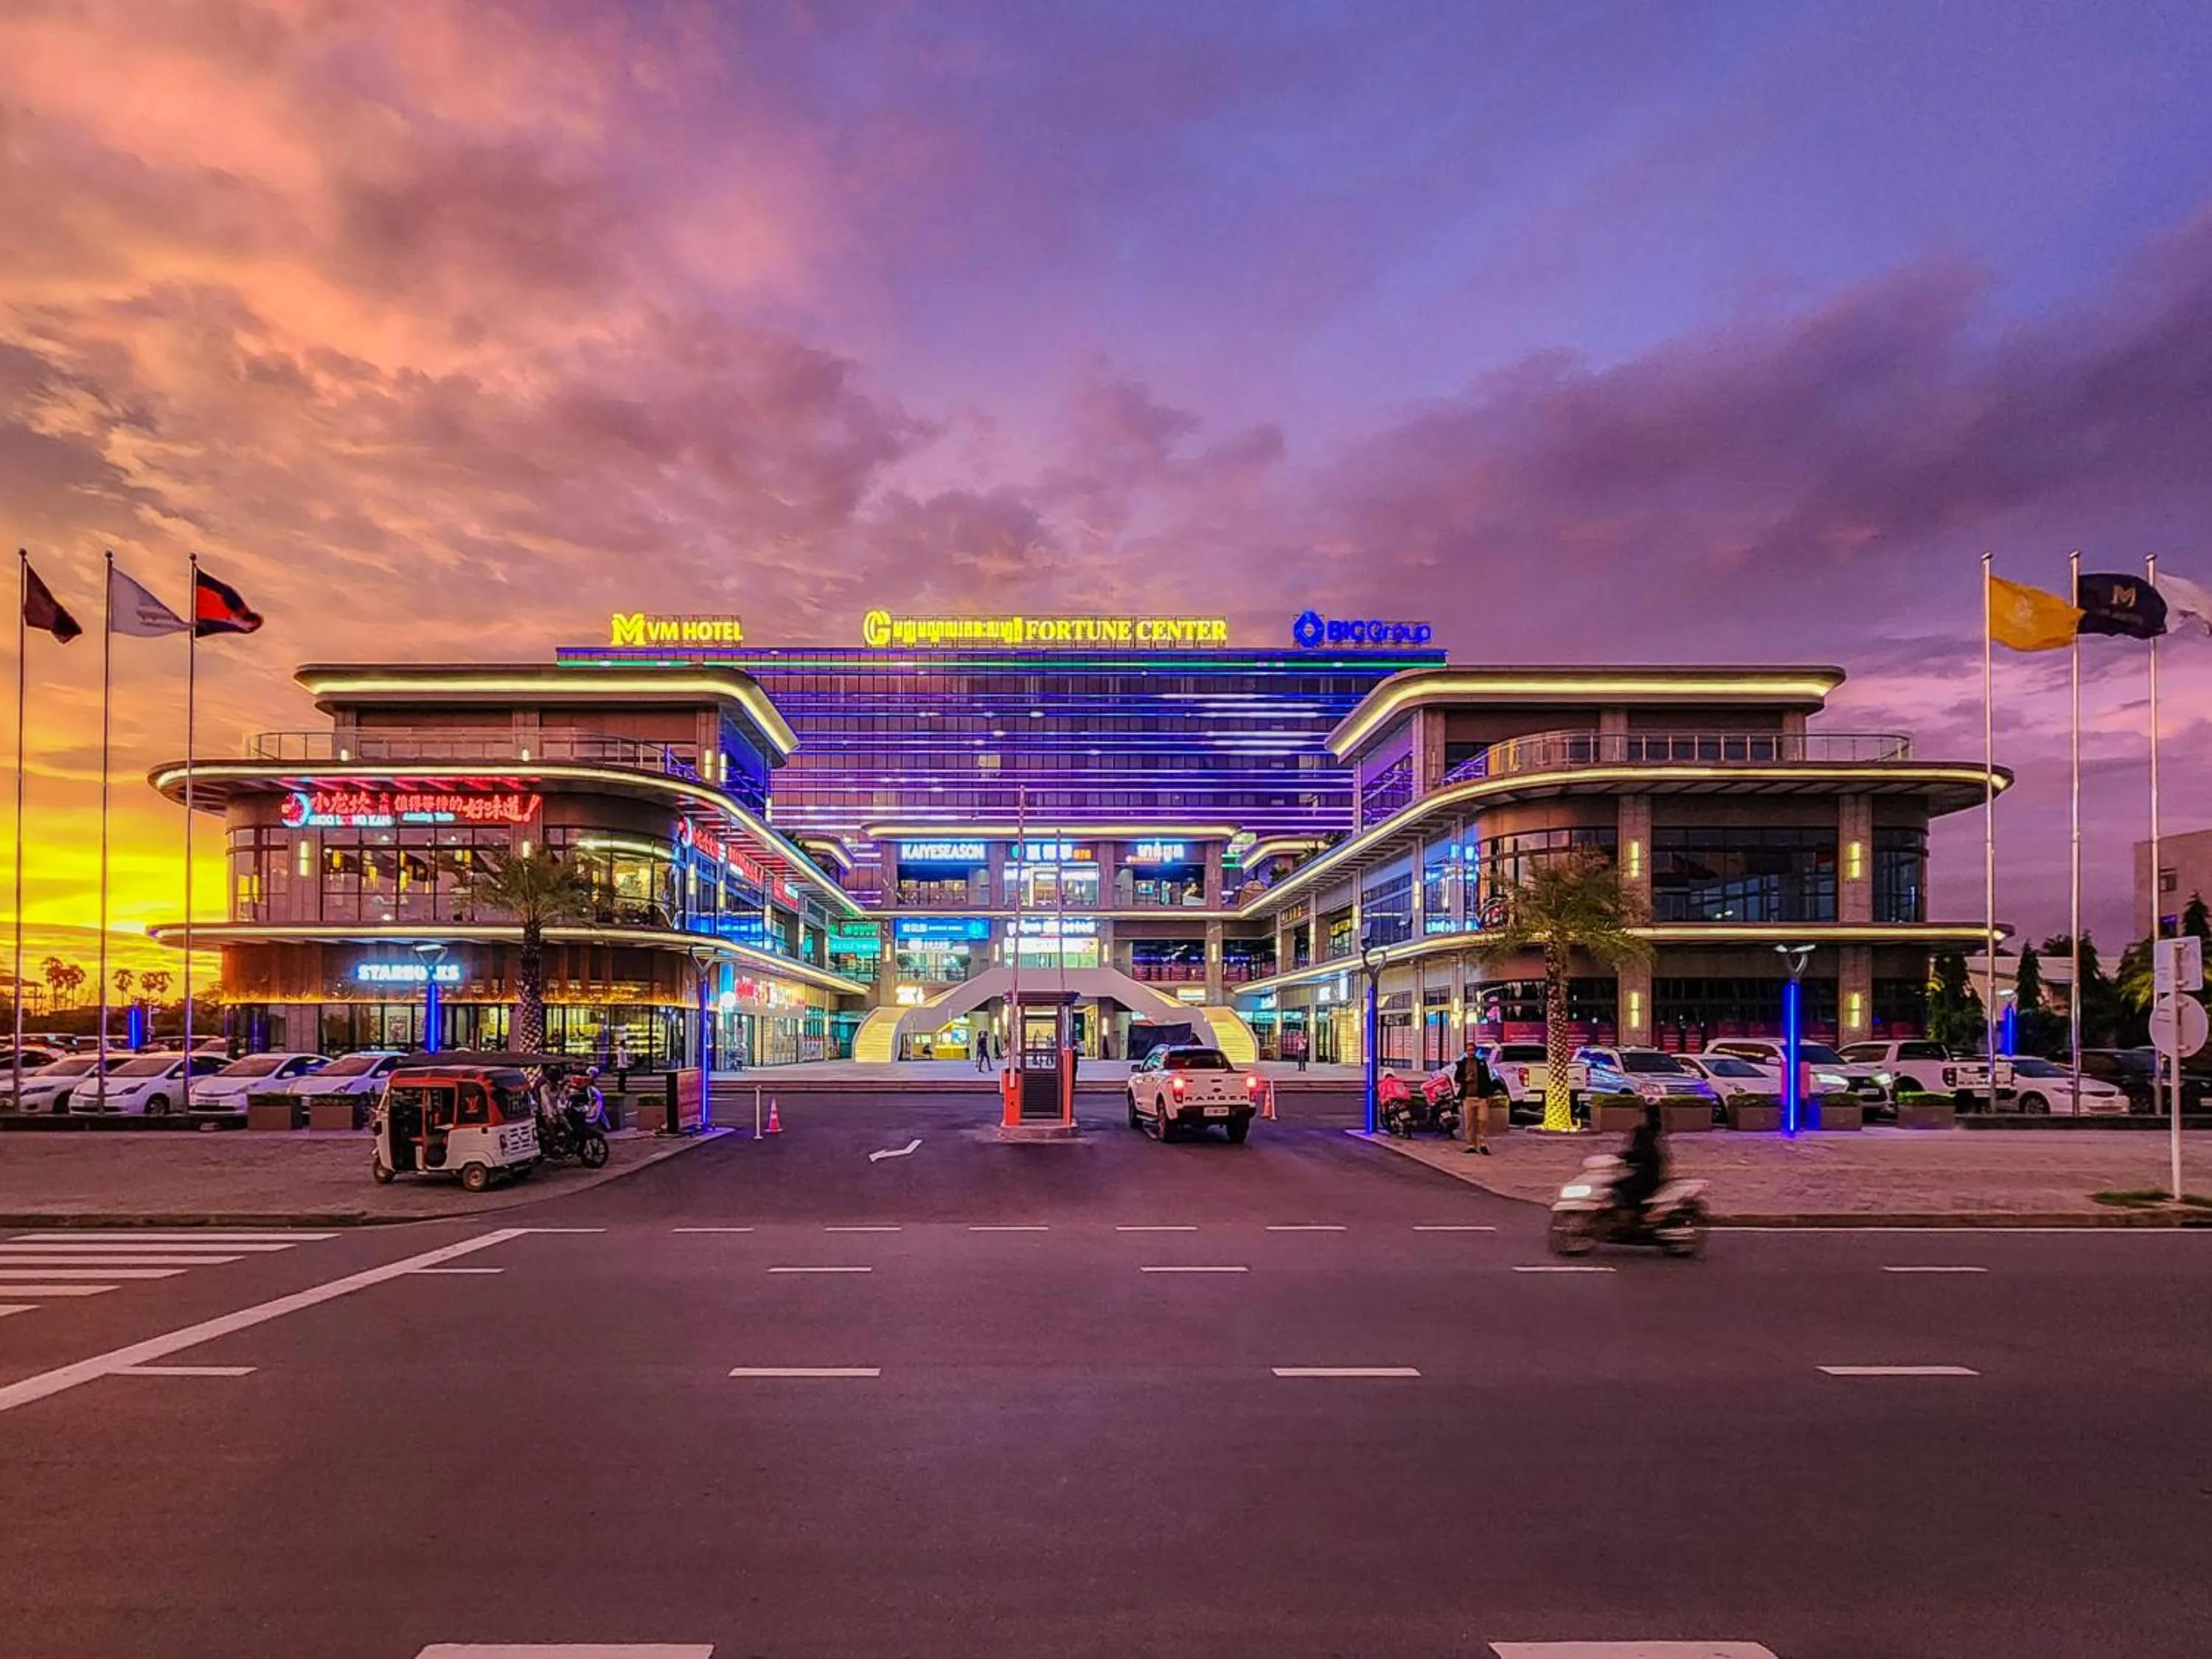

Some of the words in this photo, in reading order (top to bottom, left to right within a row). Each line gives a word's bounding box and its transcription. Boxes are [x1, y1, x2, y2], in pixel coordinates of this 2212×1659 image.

[647, 621, 679, 641] VM
[682, 621, 744, 641] HOTEL
[1025, 620, 1133, 641] FORTUNE
[1136, 619, 1227, 641] CENTER
[358, 964, 460, 981] STARBUKS
